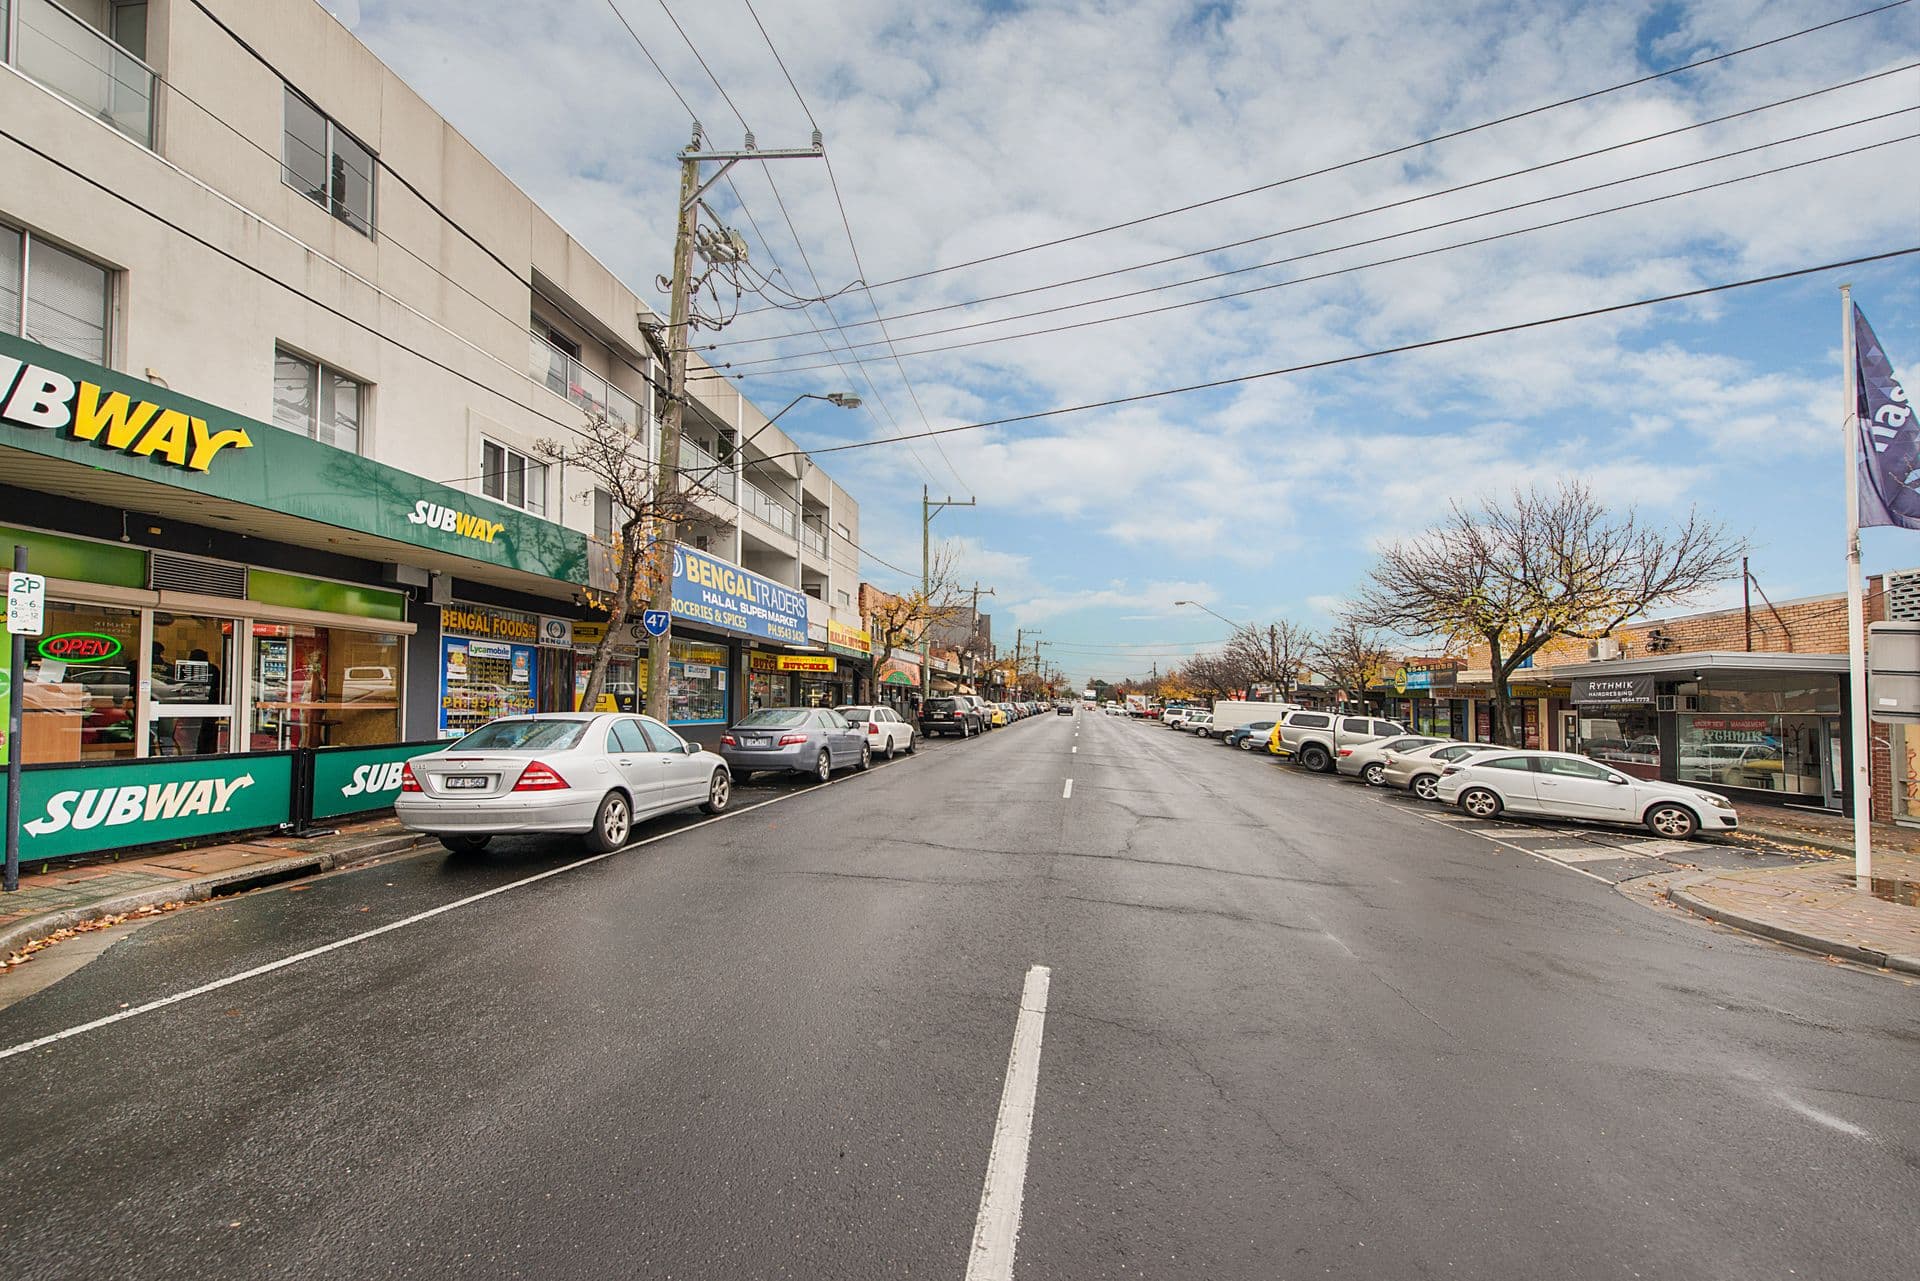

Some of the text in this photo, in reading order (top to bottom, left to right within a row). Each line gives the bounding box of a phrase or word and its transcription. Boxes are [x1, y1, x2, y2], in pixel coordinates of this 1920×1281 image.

[0, 354, 253, 472] BWAY
[407, 500, 505, 543] SUBWAY
[13, 578, 41, 593] 2P
[702, 590, 738, 611] HALAL
[647, 614, 666, 627] 47
[671, 597, 747, 629] ROCERIES & SPICES
[442, 609, 490, 633] BENGAL
[493, 618, 529, 638] FOODS
[49, 638, 110, 656] OPEN
[470, 643, 510, 655] Lycamobile
[541, 637, 570, 645] BENGAL
[783, 662, 829, 670] BUTCHER
[1589, 681, 1633, 690] RYTHMIK
[471, 698, 503, 708] 9543
[507, 699, 535, 708] 1426
[1730, 720, 1766, 728] MANAGEMENT
[341, 762, 404, 798] SUB
[23, 772, 255, 838] SUBWAY
